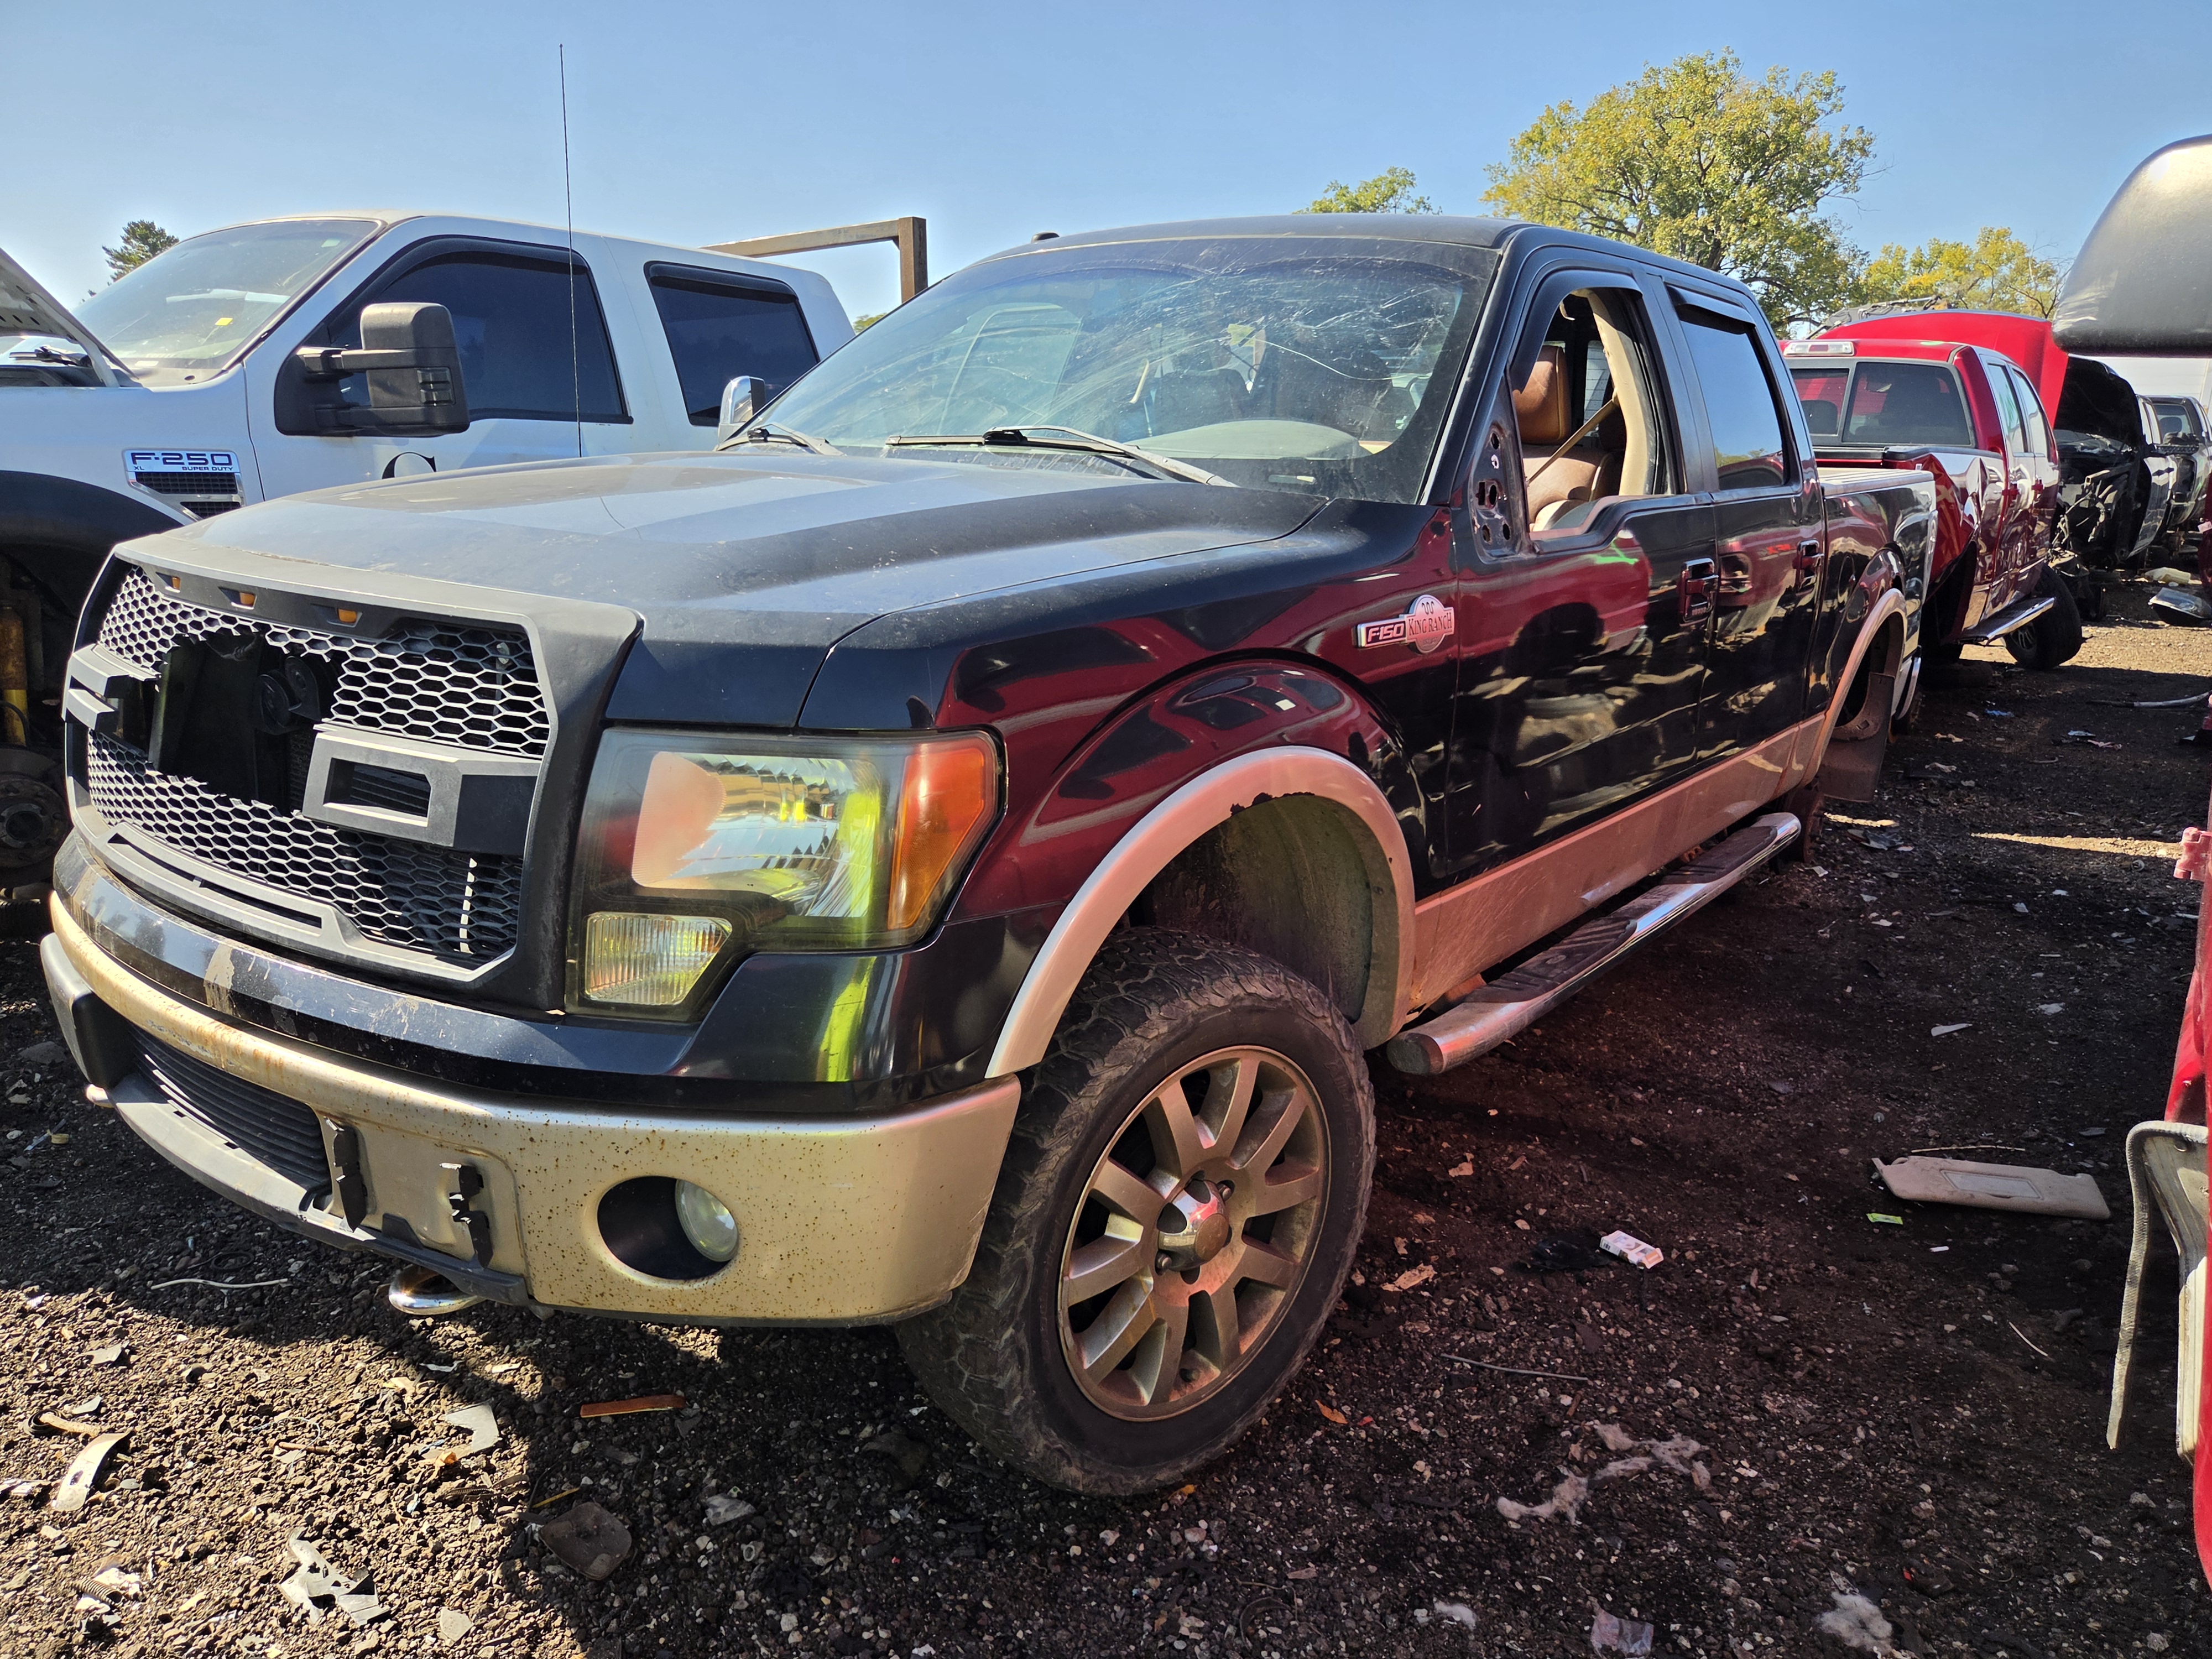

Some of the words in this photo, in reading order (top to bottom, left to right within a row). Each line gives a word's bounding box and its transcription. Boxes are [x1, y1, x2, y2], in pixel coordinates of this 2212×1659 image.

[131, 452, 232, 466] F-250
[1368, 623, 1405, 643] F-150
[1408, 617, 1427, 637] KING
[1428, 612, 1453, 633] RANCH
